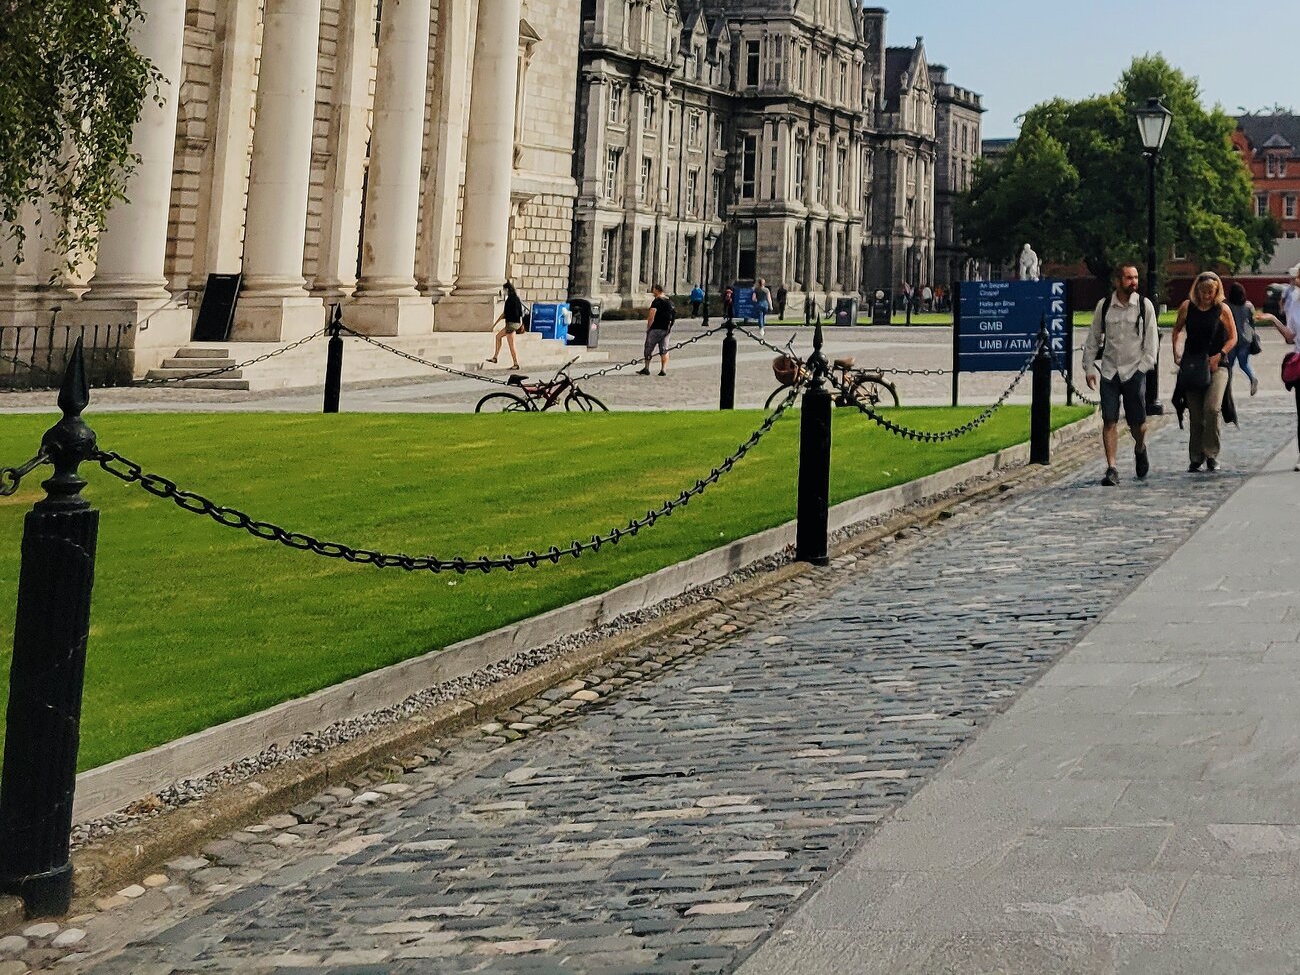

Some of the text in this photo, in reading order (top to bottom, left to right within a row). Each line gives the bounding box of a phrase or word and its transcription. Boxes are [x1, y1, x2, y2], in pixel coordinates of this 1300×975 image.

[979, 321, 1003, 331] GMB
[979, 339, 1003, 349] UMB
[1010, 339, 1032, 349] ATM
